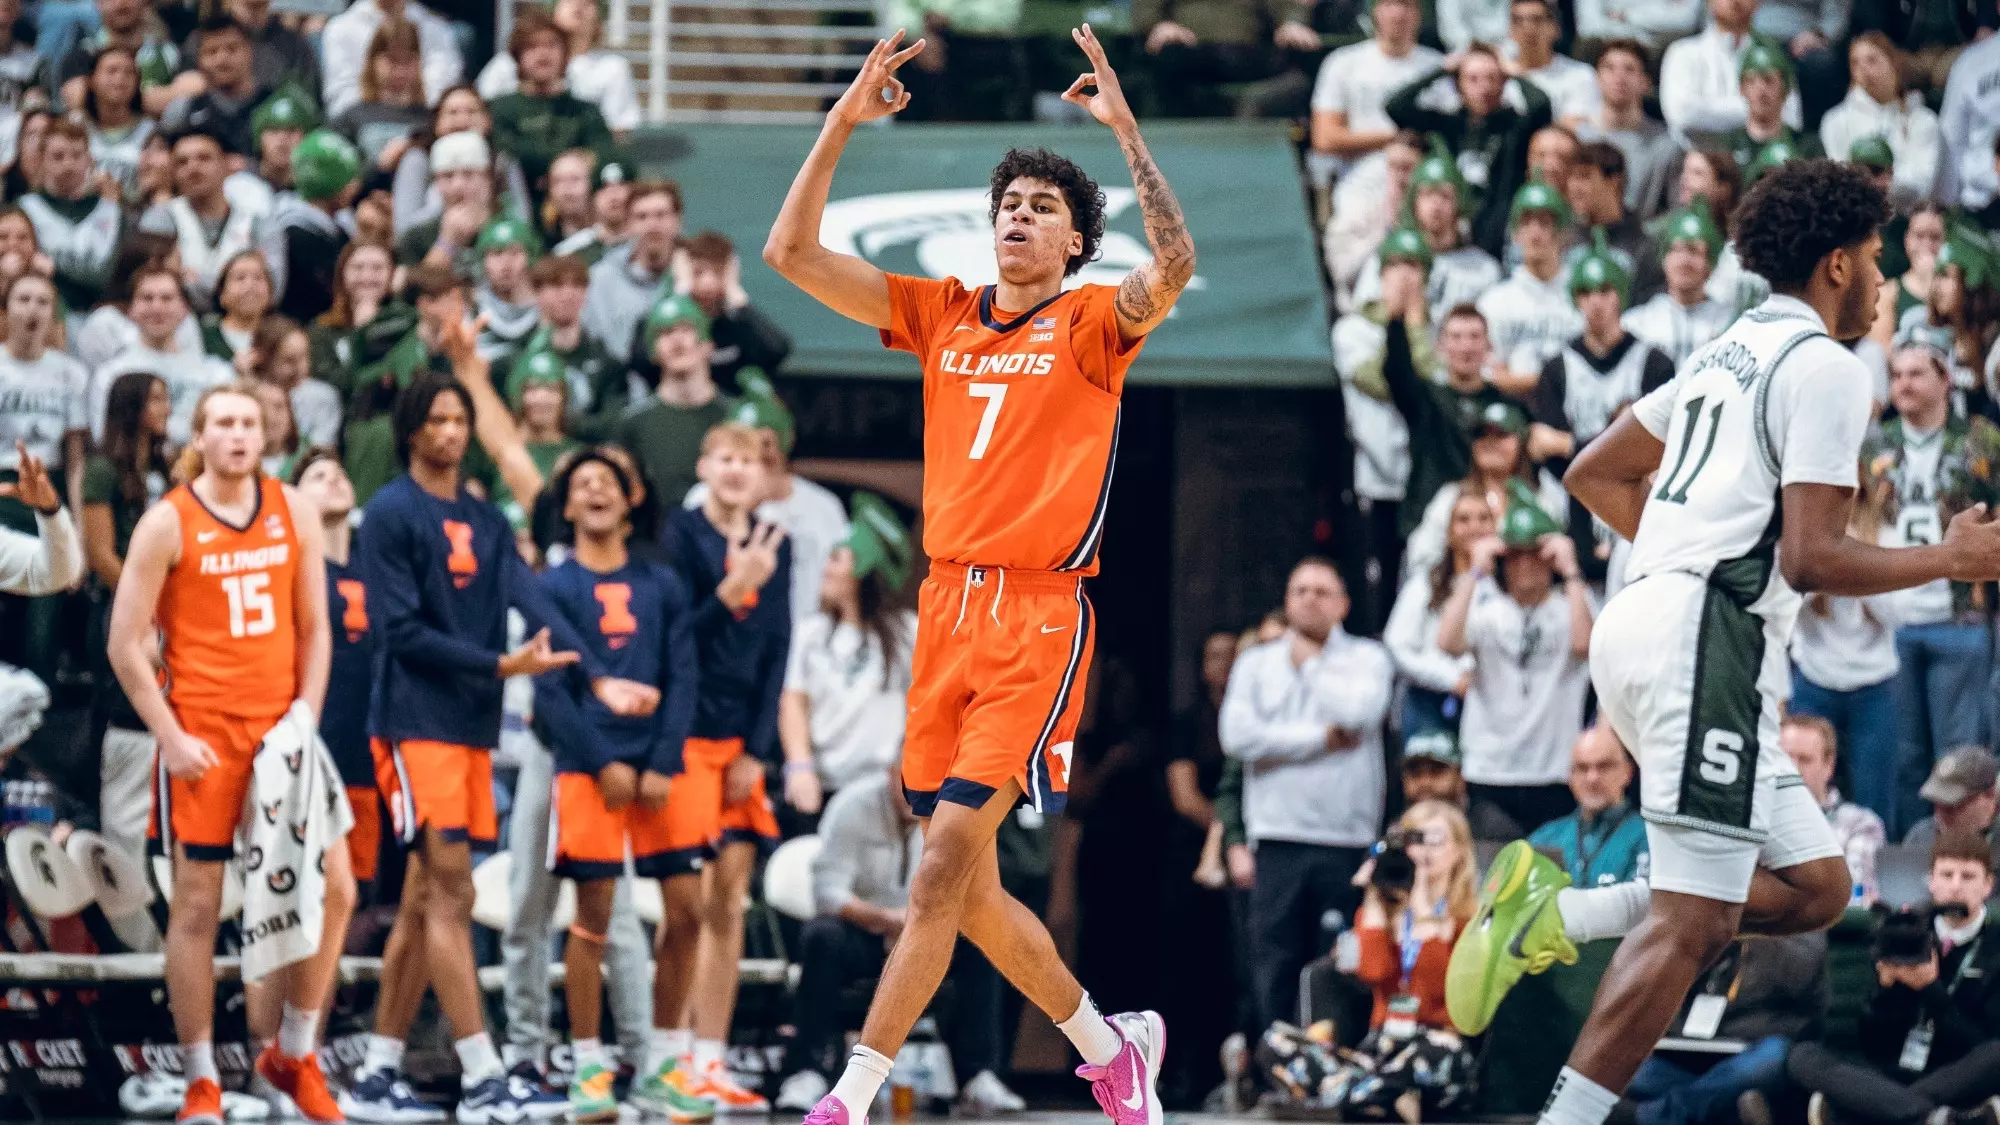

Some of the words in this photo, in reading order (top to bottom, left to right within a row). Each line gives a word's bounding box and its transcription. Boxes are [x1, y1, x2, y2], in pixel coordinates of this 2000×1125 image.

[940, 350, 1056, 376] ILLINOIS
[968, 383, 1009, 460] 7
[1655, 395, 1726, 505] 11
[201, 543, 289, 575] ILLINOIS
[222, 571, 276, 637] 15
[1700, 727, 1744, 786] S
